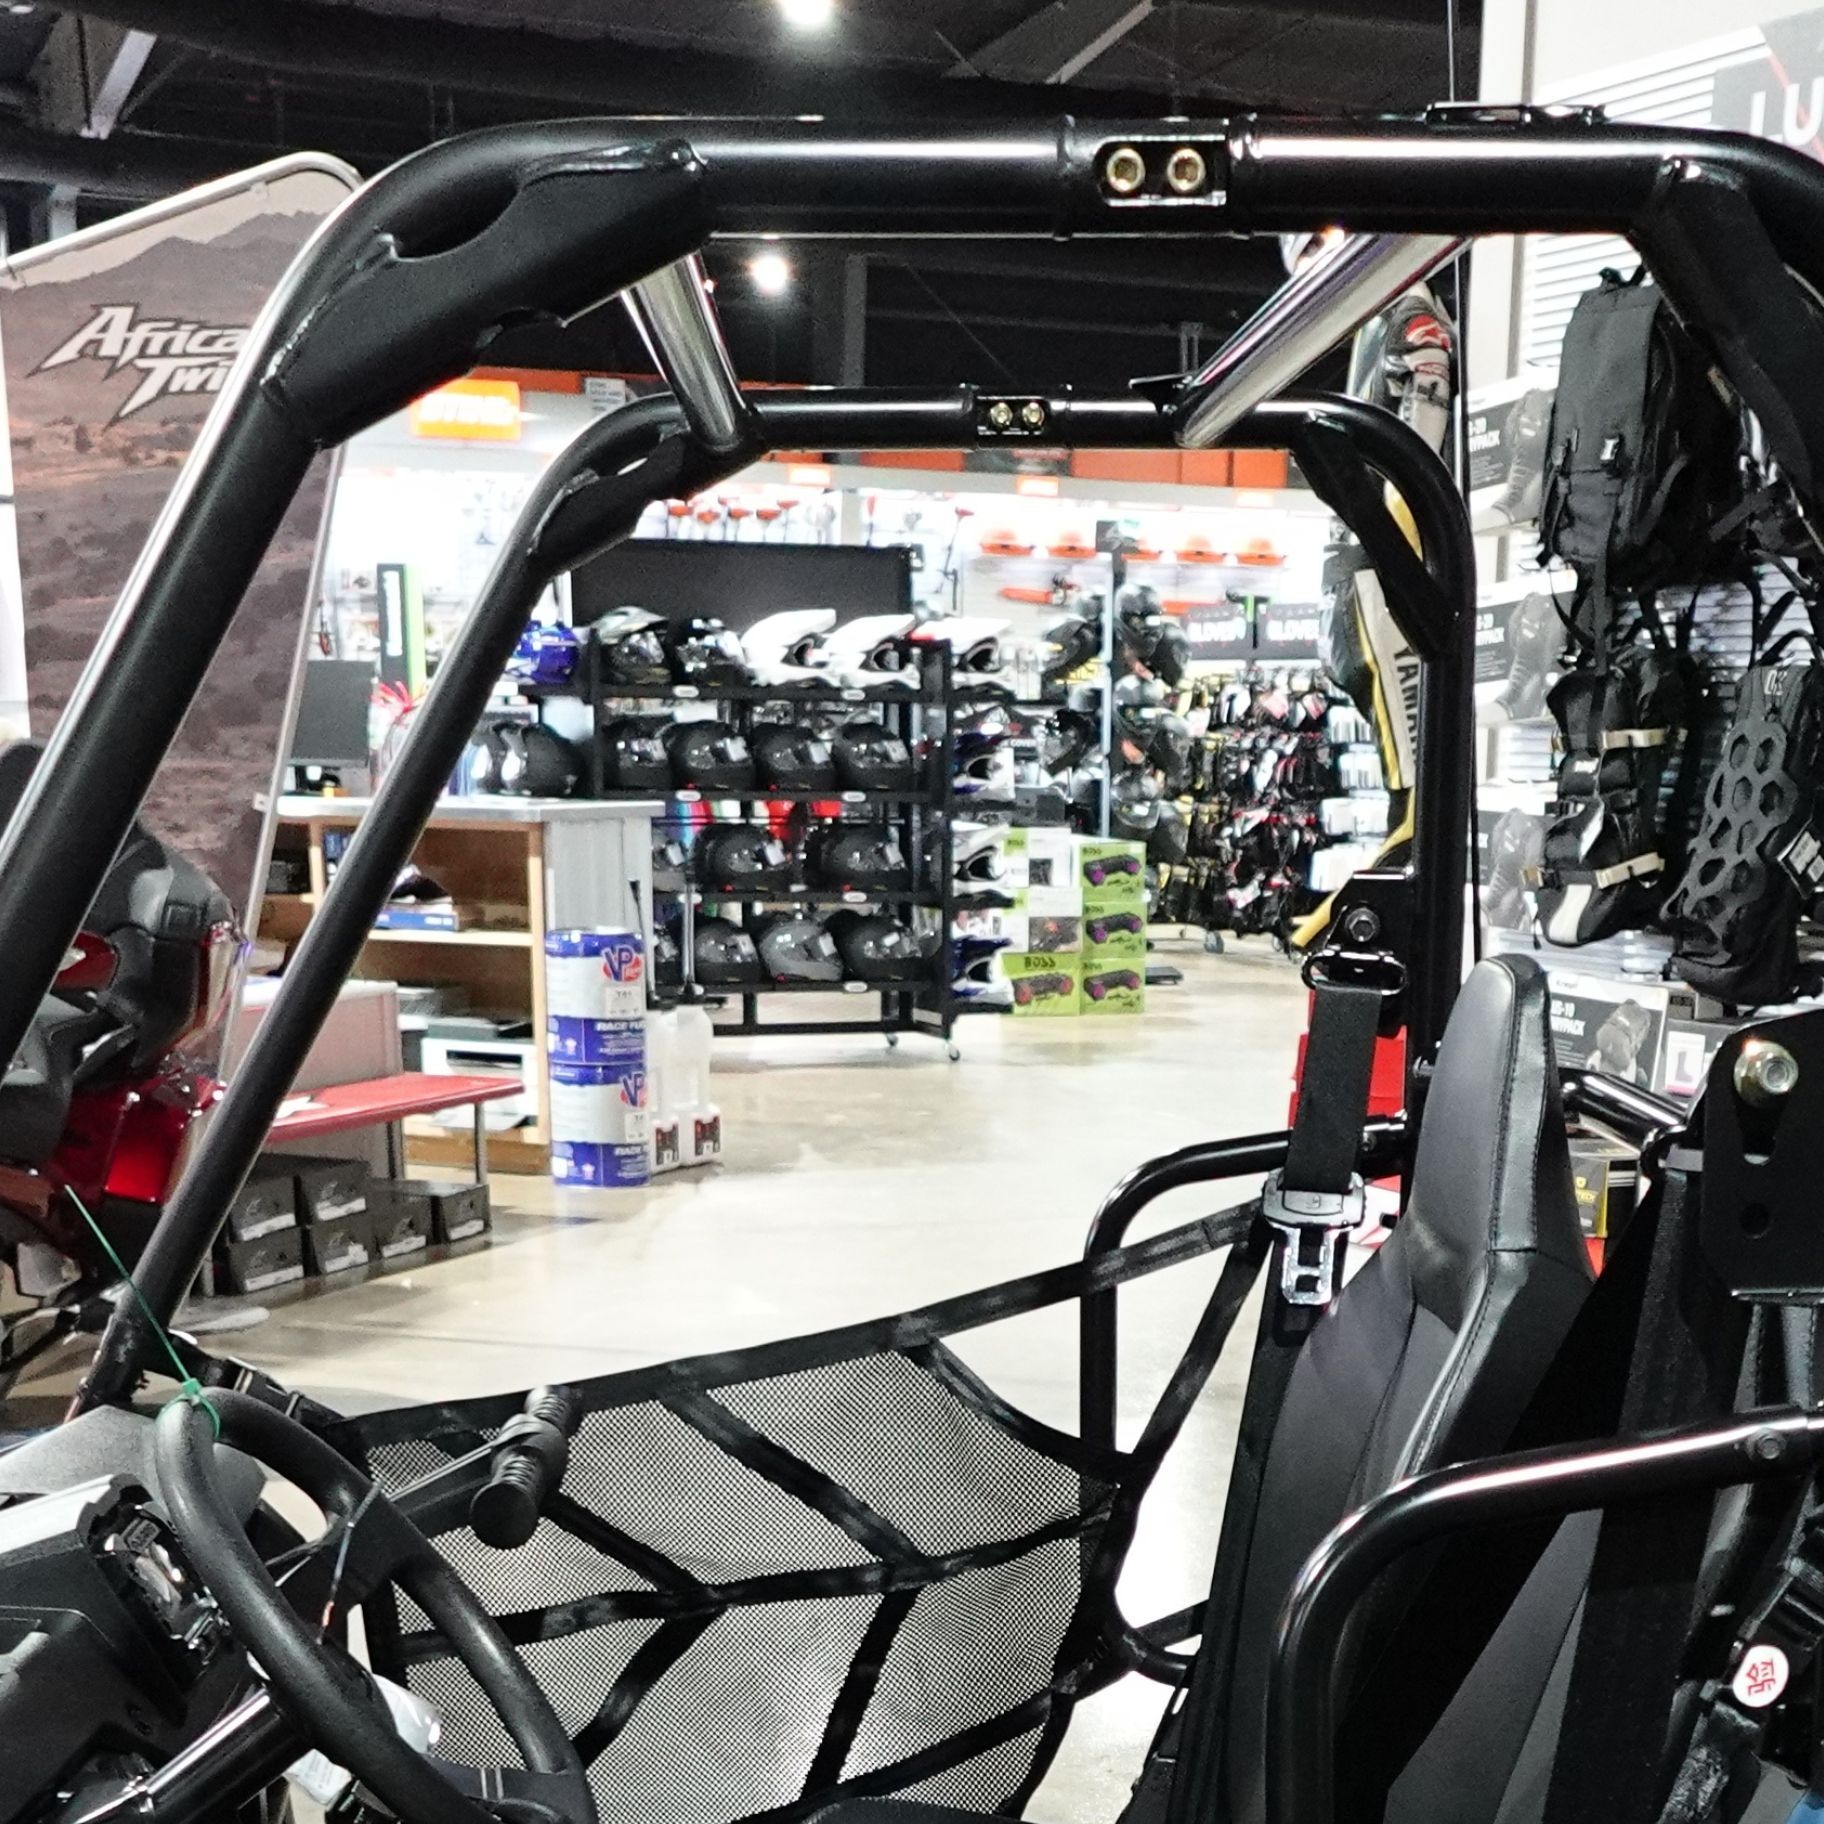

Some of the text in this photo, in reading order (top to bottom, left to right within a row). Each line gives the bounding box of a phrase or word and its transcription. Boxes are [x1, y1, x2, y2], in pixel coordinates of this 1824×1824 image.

[26, 302, 253, 380] Africa
[102, 356, 233, 434] Twi
[602, 945, 635, 983] VP
[1024, 956, 1057, 969] BOSS
[596, 1020, 628, 1032] RACE
